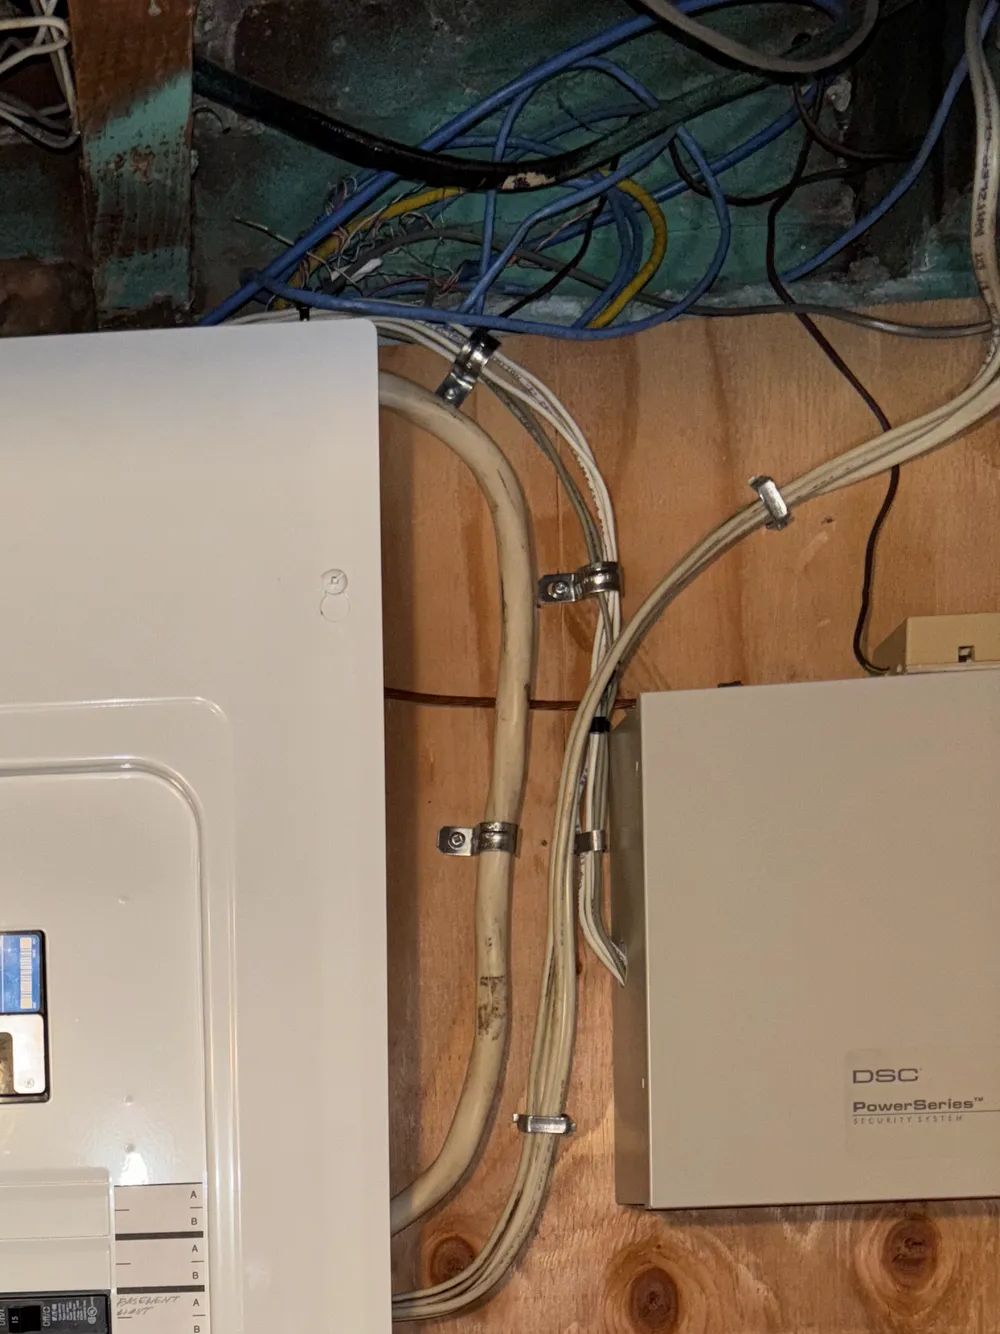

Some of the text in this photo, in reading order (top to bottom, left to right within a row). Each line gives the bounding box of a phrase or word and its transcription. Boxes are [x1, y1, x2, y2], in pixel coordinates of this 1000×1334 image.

[852, 1068, 919, 1084] DSC
[853, 1114, 964, 1125] SECURITY SYSTEM
[189, 1190, 198, 1199] A
[190, 1217, 198, 1226] B
[12, 1315, 19, 1324] 15
